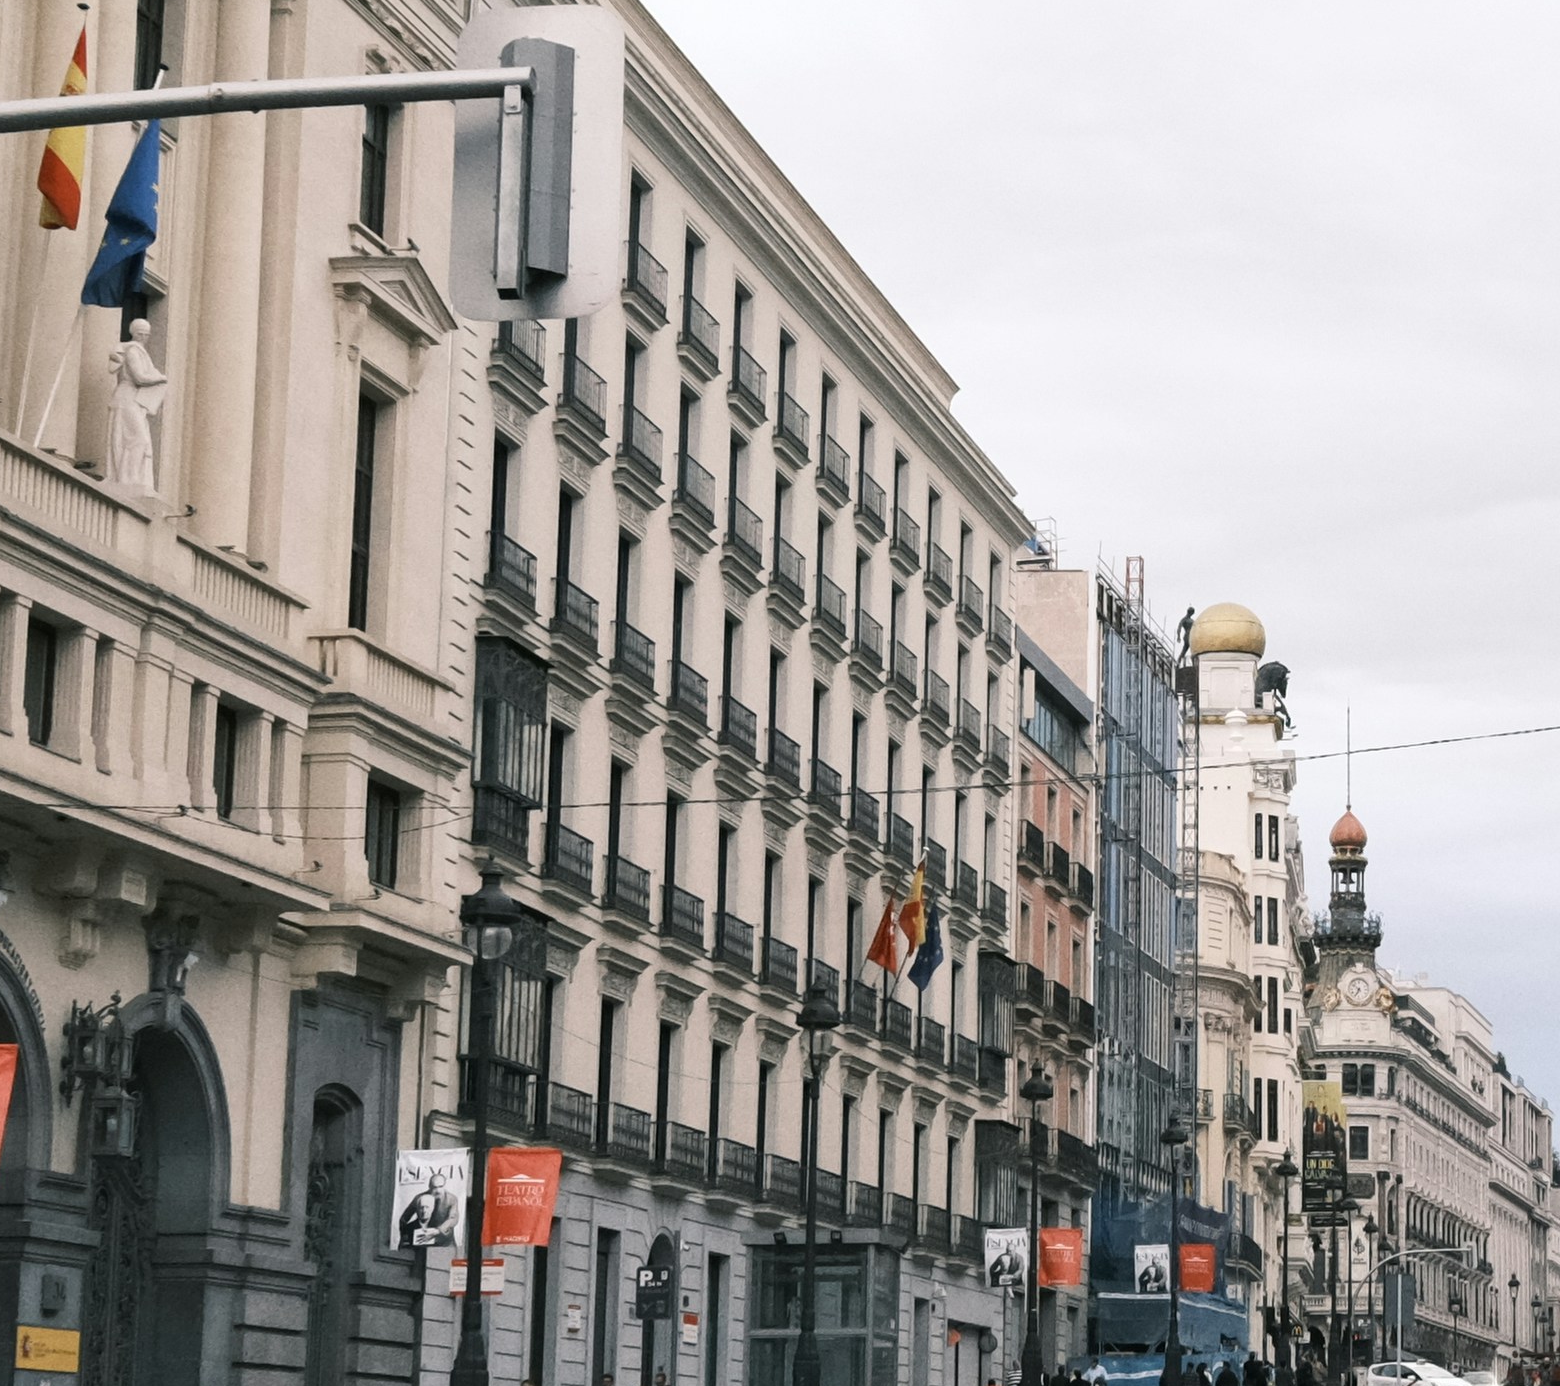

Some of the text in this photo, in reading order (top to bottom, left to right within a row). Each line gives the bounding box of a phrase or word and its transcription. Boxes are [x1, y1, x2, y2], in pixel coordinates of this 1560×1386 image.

[496, 1185, 545, 1196] TEATRO
[496, 1195, 546, 1208] ESPAÑOL
[639, 1270, 654, 1287] P
